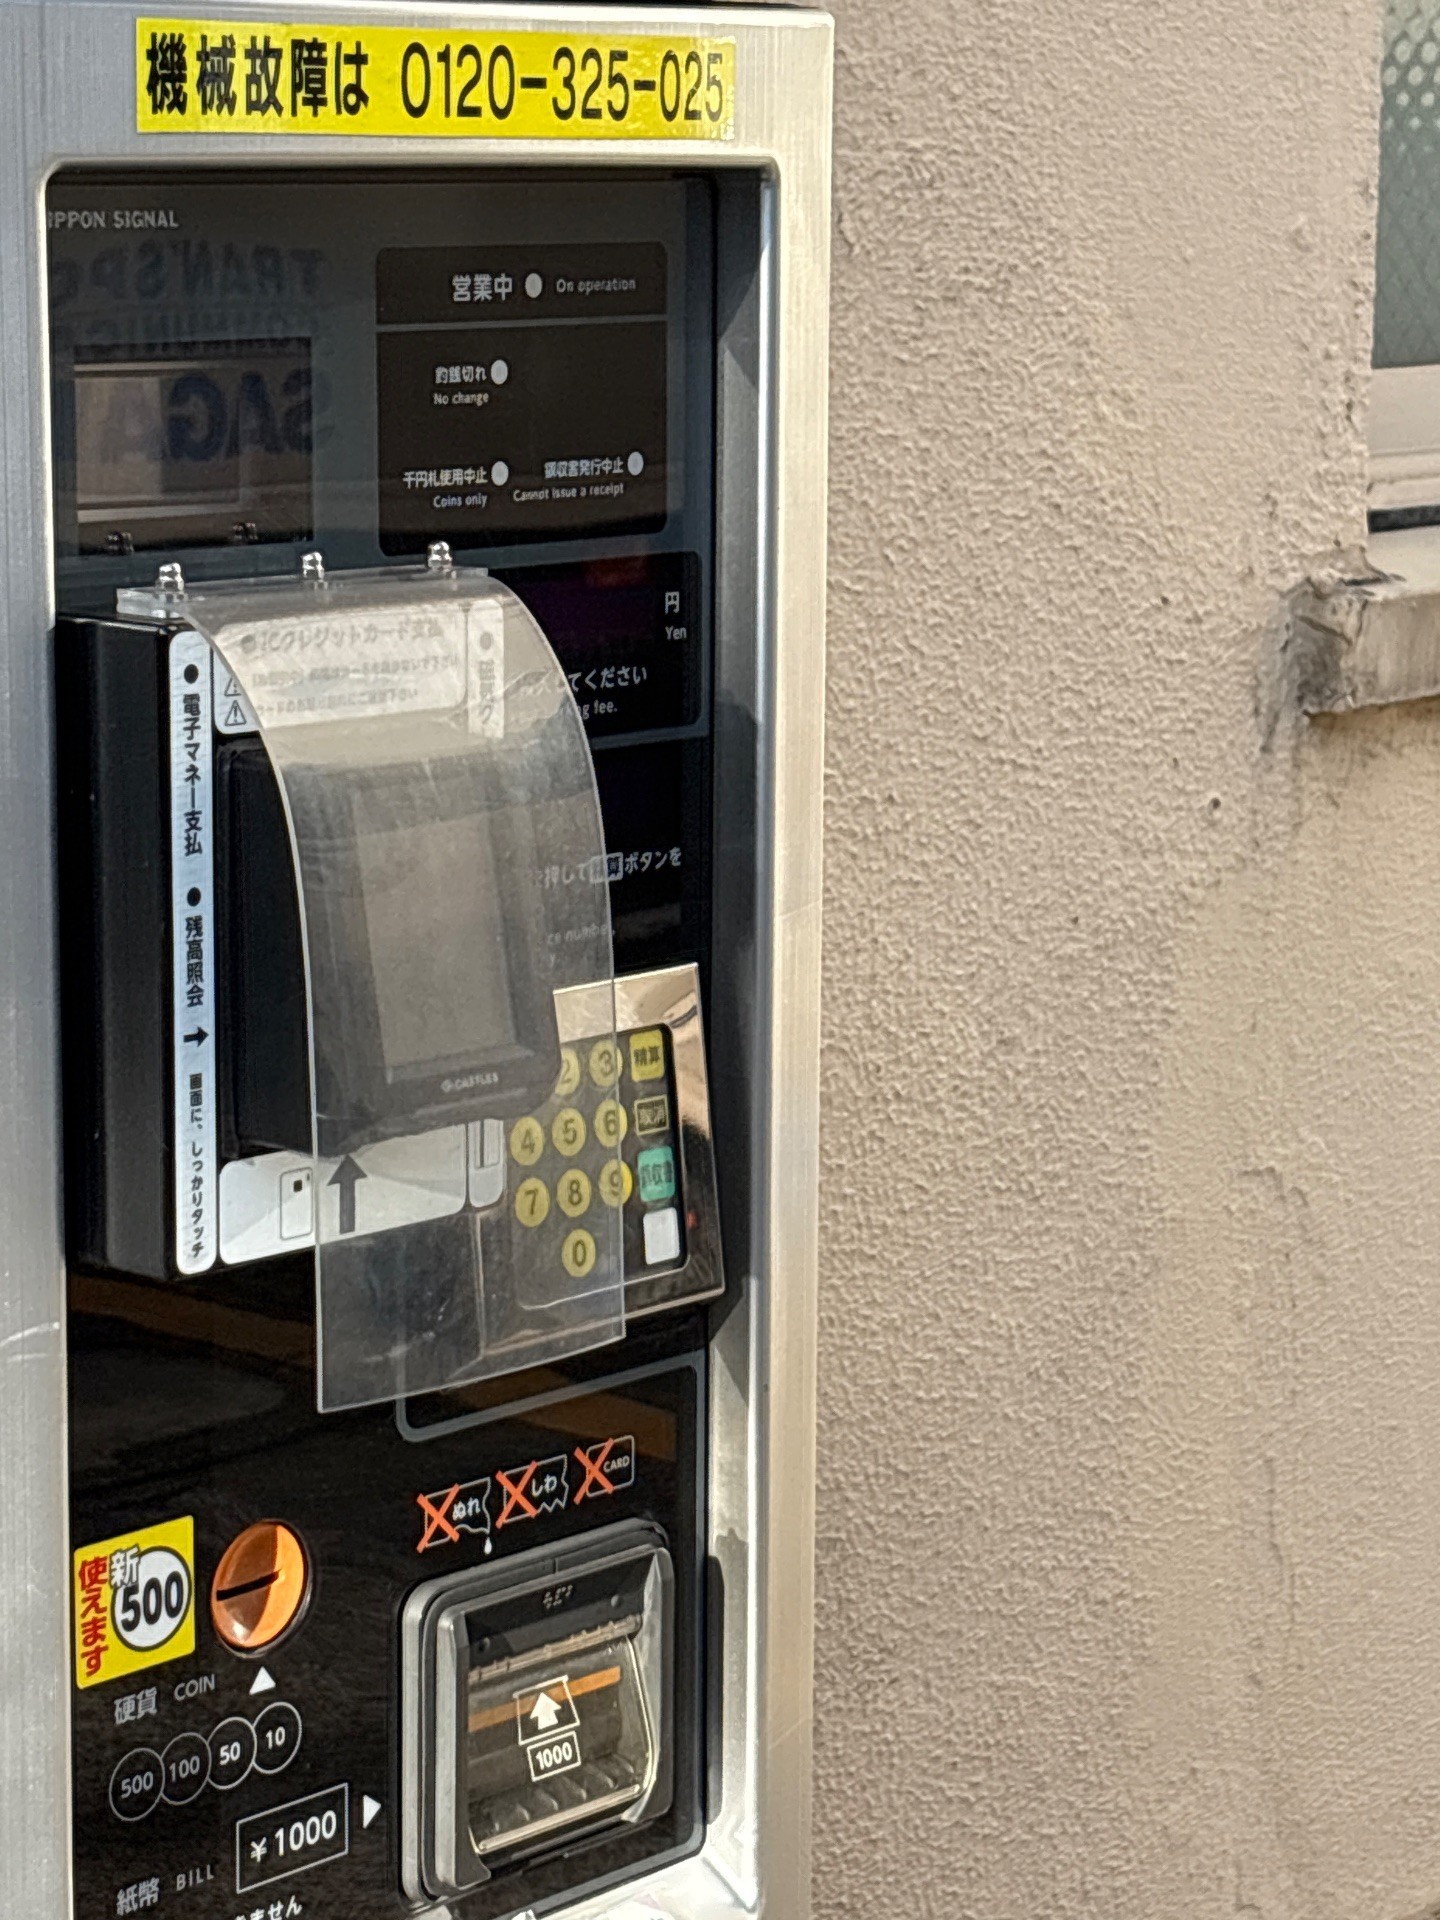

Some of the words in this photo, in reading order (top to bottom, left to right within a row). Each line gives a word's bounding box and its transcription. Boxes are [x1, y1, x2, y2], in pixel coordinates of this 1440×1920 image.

[146, 32, 369, 117] 機械故障は
[401, 42, 722, 122] 0120-325-025
[113, 210, 180, 229] SIGNAL
[452, 272, 513, 302] 営業中
[577, 278, 636, 296] operation
[435, 366, 487, 384] 釣銭切れ
[433, 392, 449, 405] No
[452, 391, 489, 407] change
[403, 466, 488, 489] 千円札使用中止
[433, 494, 462, 508] Coins
[465, 493, 488, 508] only
[512, 488, 549, 502] Cannot
[552, 485, 577, 499] issue
[580, 486, 587, 497] a
[589, 482, 624, 497] receipt
[664, 591, 680, 615] 円
[665, 626, 687, 641] Yen
[567, 665, 648, 692] てください
[593, 701, 618, 715] fee.
[182, 693, 203, 857] 電子マネー支払
[185, 914, 204, 1008] 残高照会
[598, 1049, 614, 1077] 3
[562, 1118, 578, 1145] 5
[604, 1110, 618, 1136] 6
[521, 1128, 536, 1156] 4
[568, 1178, 583, 1206] 8
[609, 1169, 623, 1197] 9
[524, 1188, 540, 1217] 7
[572, 1239, 587, 1267] 0
[603, 1455, 631, 1473] CARD
[531, 1473, 558, 1497] しわ
[453, 1496, 481, 1520] ぬれ
[109, 1545, 141, 1590] 新
[78, 1554, 109, 1677] 使えます
[121, 1571, 184, 1633] 500
[173, 1674, 217, 1702] COIN
[113, 1686, 159, 1726] 硬貨
[265, 1726, 287, 1750] 10
[219, 1741, 242, 1767] 50
[535, 1741, 572, 1770] 1000
[168, 1755, 201, 1784] 100
[120, 1771, 155, 1799] 500
[176, 1863, 215, 1892] BILL
[116, 1878, 160, 1916] 紙幣
[234, 1895, 303, 1920] ません
